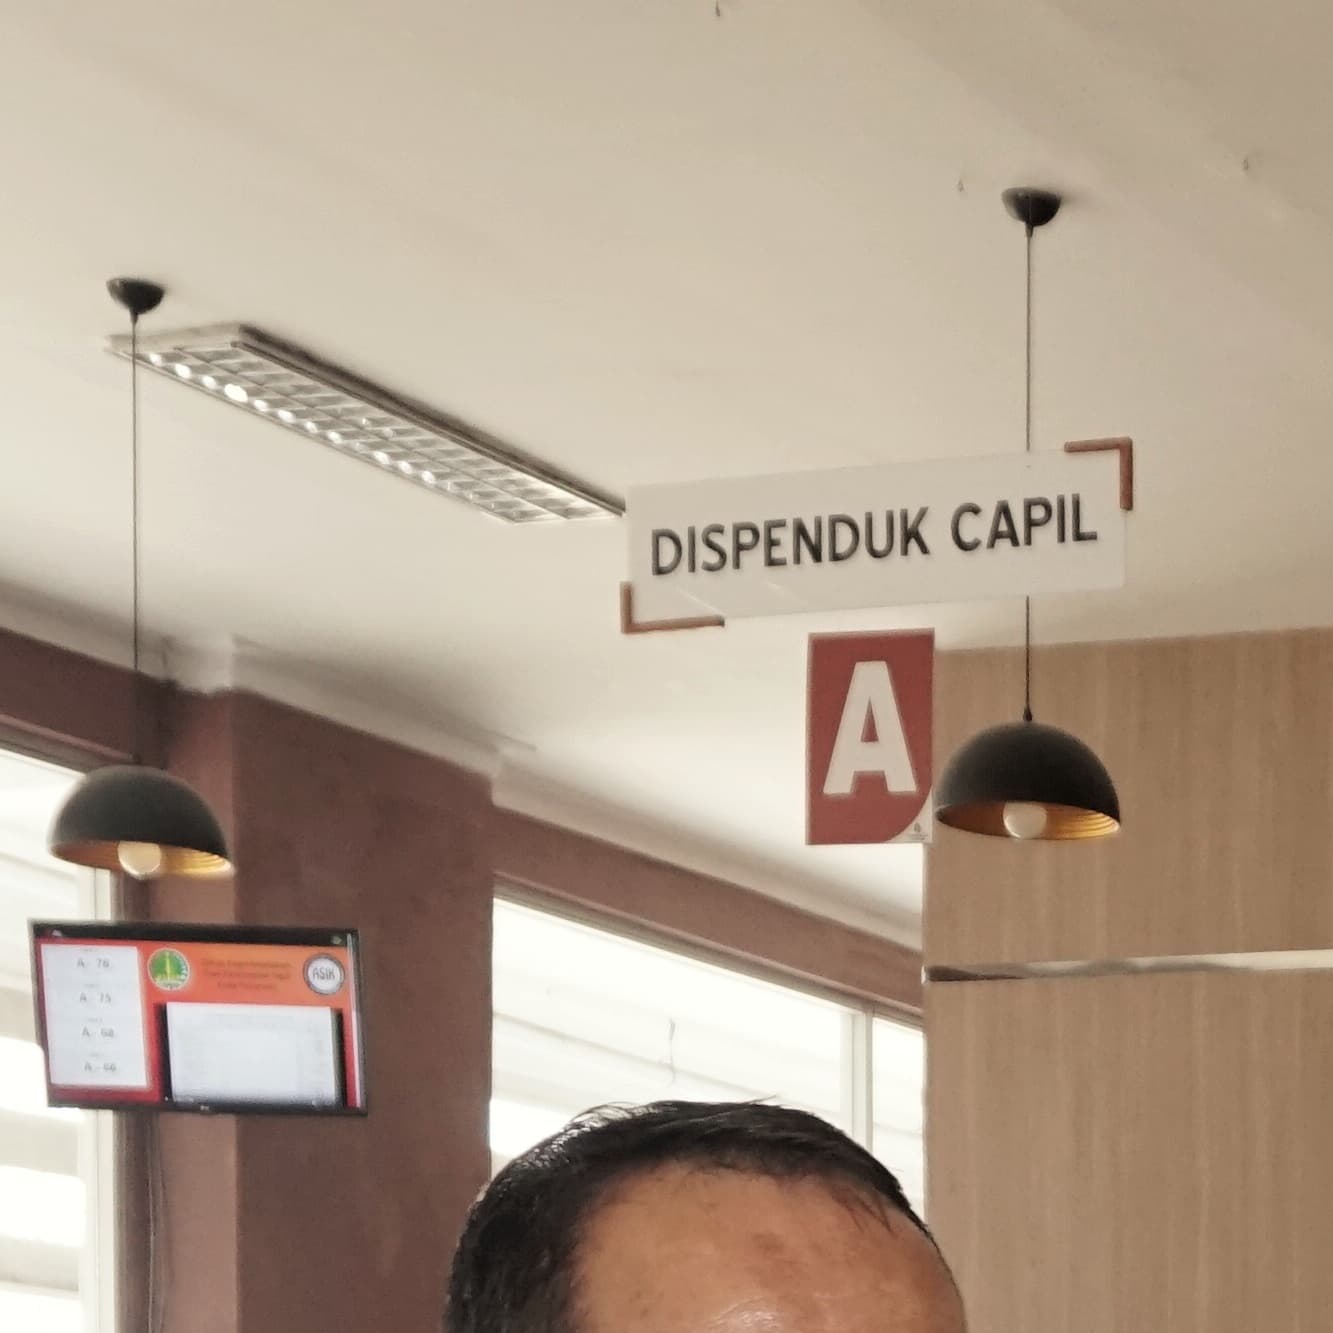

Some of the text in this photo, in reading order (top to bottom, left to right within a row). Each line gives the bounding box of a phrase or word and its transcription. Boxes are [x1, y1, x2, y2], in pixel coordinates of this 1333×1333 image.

[651, 493, 1098, 576] DISPENDUK CAPIL
[822, 660, 918, 795] A
[312, 968, 336, 981] ASIK
